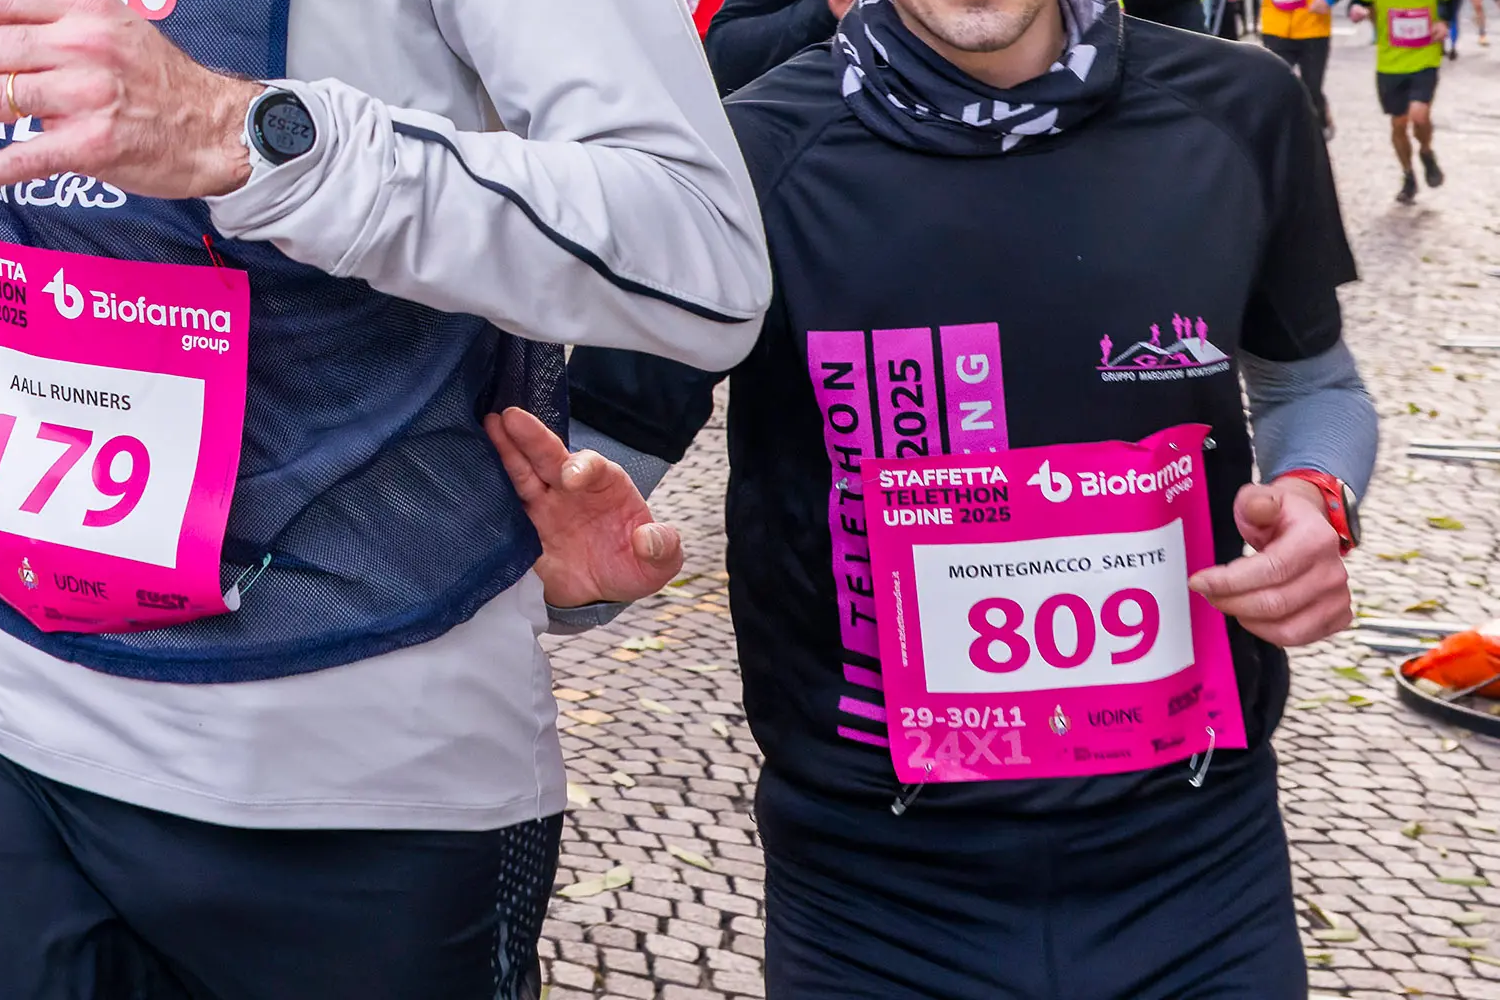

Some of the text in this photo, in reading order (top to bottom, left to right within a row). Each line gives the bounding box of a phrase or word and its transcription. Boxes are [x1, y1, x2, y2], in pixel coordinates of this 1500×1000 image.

[89, 290, 232, 333] Biofarma
[181, 334, 231, 355] group
[9, 373, 132, 411] AALL RUNNERS
[887, 358, 930, 459] 2025
[955, 353, 996, 454] NG
[820, 361, 878, 628] TELETHON
[879, 465, 1009, 488] STAFFETTA
[1076, 454, 1193, 497] Biofarma
[880, 485, 1010, 507] TELETHON
[882, 507, 1012, 527] UDINE 2025
[54, 572, 109, 600] UDINE
[967, 587, 1161, 674] 809
[900, 705, 1027, 730] 29-30/11
[1087, 706, 1144, 727] UDINE
[904, 729, 1032, 769] 24X1
